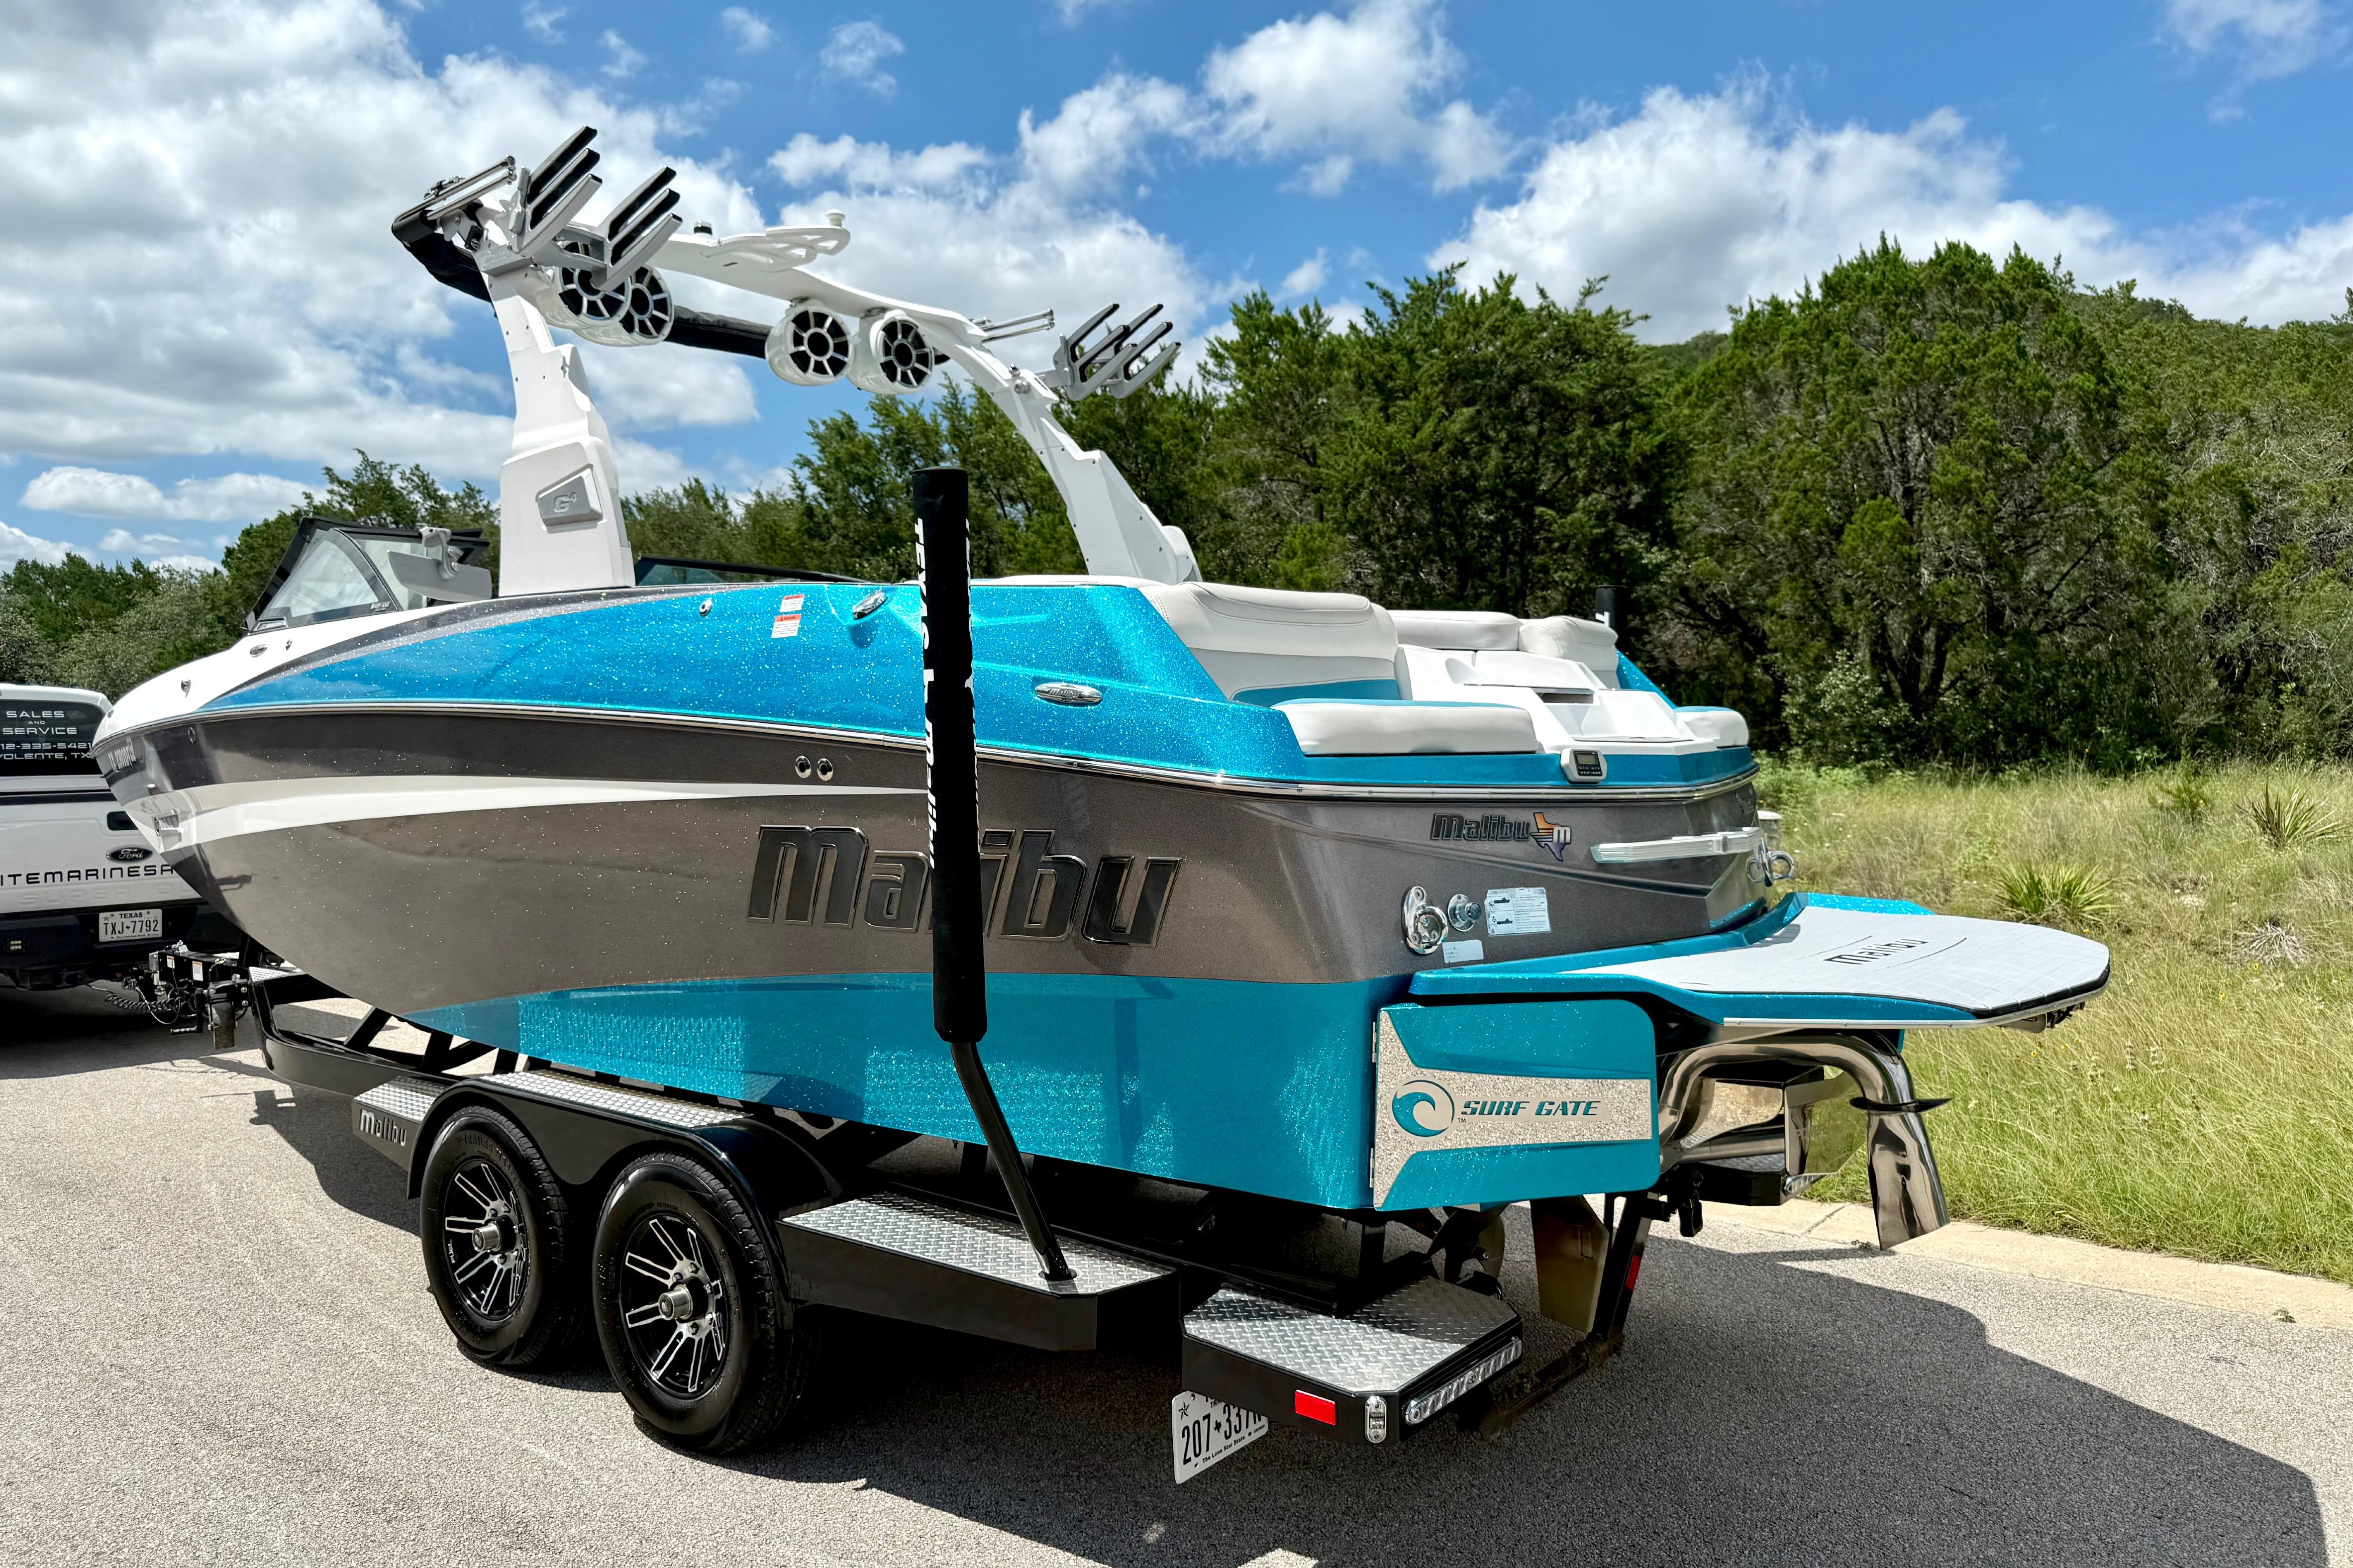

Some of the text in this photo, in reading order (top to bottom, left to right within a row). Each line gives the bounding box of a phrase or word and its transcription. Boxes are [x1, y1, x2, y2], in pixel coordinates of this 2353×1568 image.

[1430, 813, 1531, 842] Malibu
[118, 849, 143, 859] Ford
[746, 825, 1183, 948] Maibu
[1461, 1101, 1601, 1116] SURF GATE
[359, 1108, 407, 1147] Malibu
[1212, 1449, 1223, 1458] Lone
[1223, 1443, 1232, 1451] Star
[1233, 1436, 1245, 1446] State
